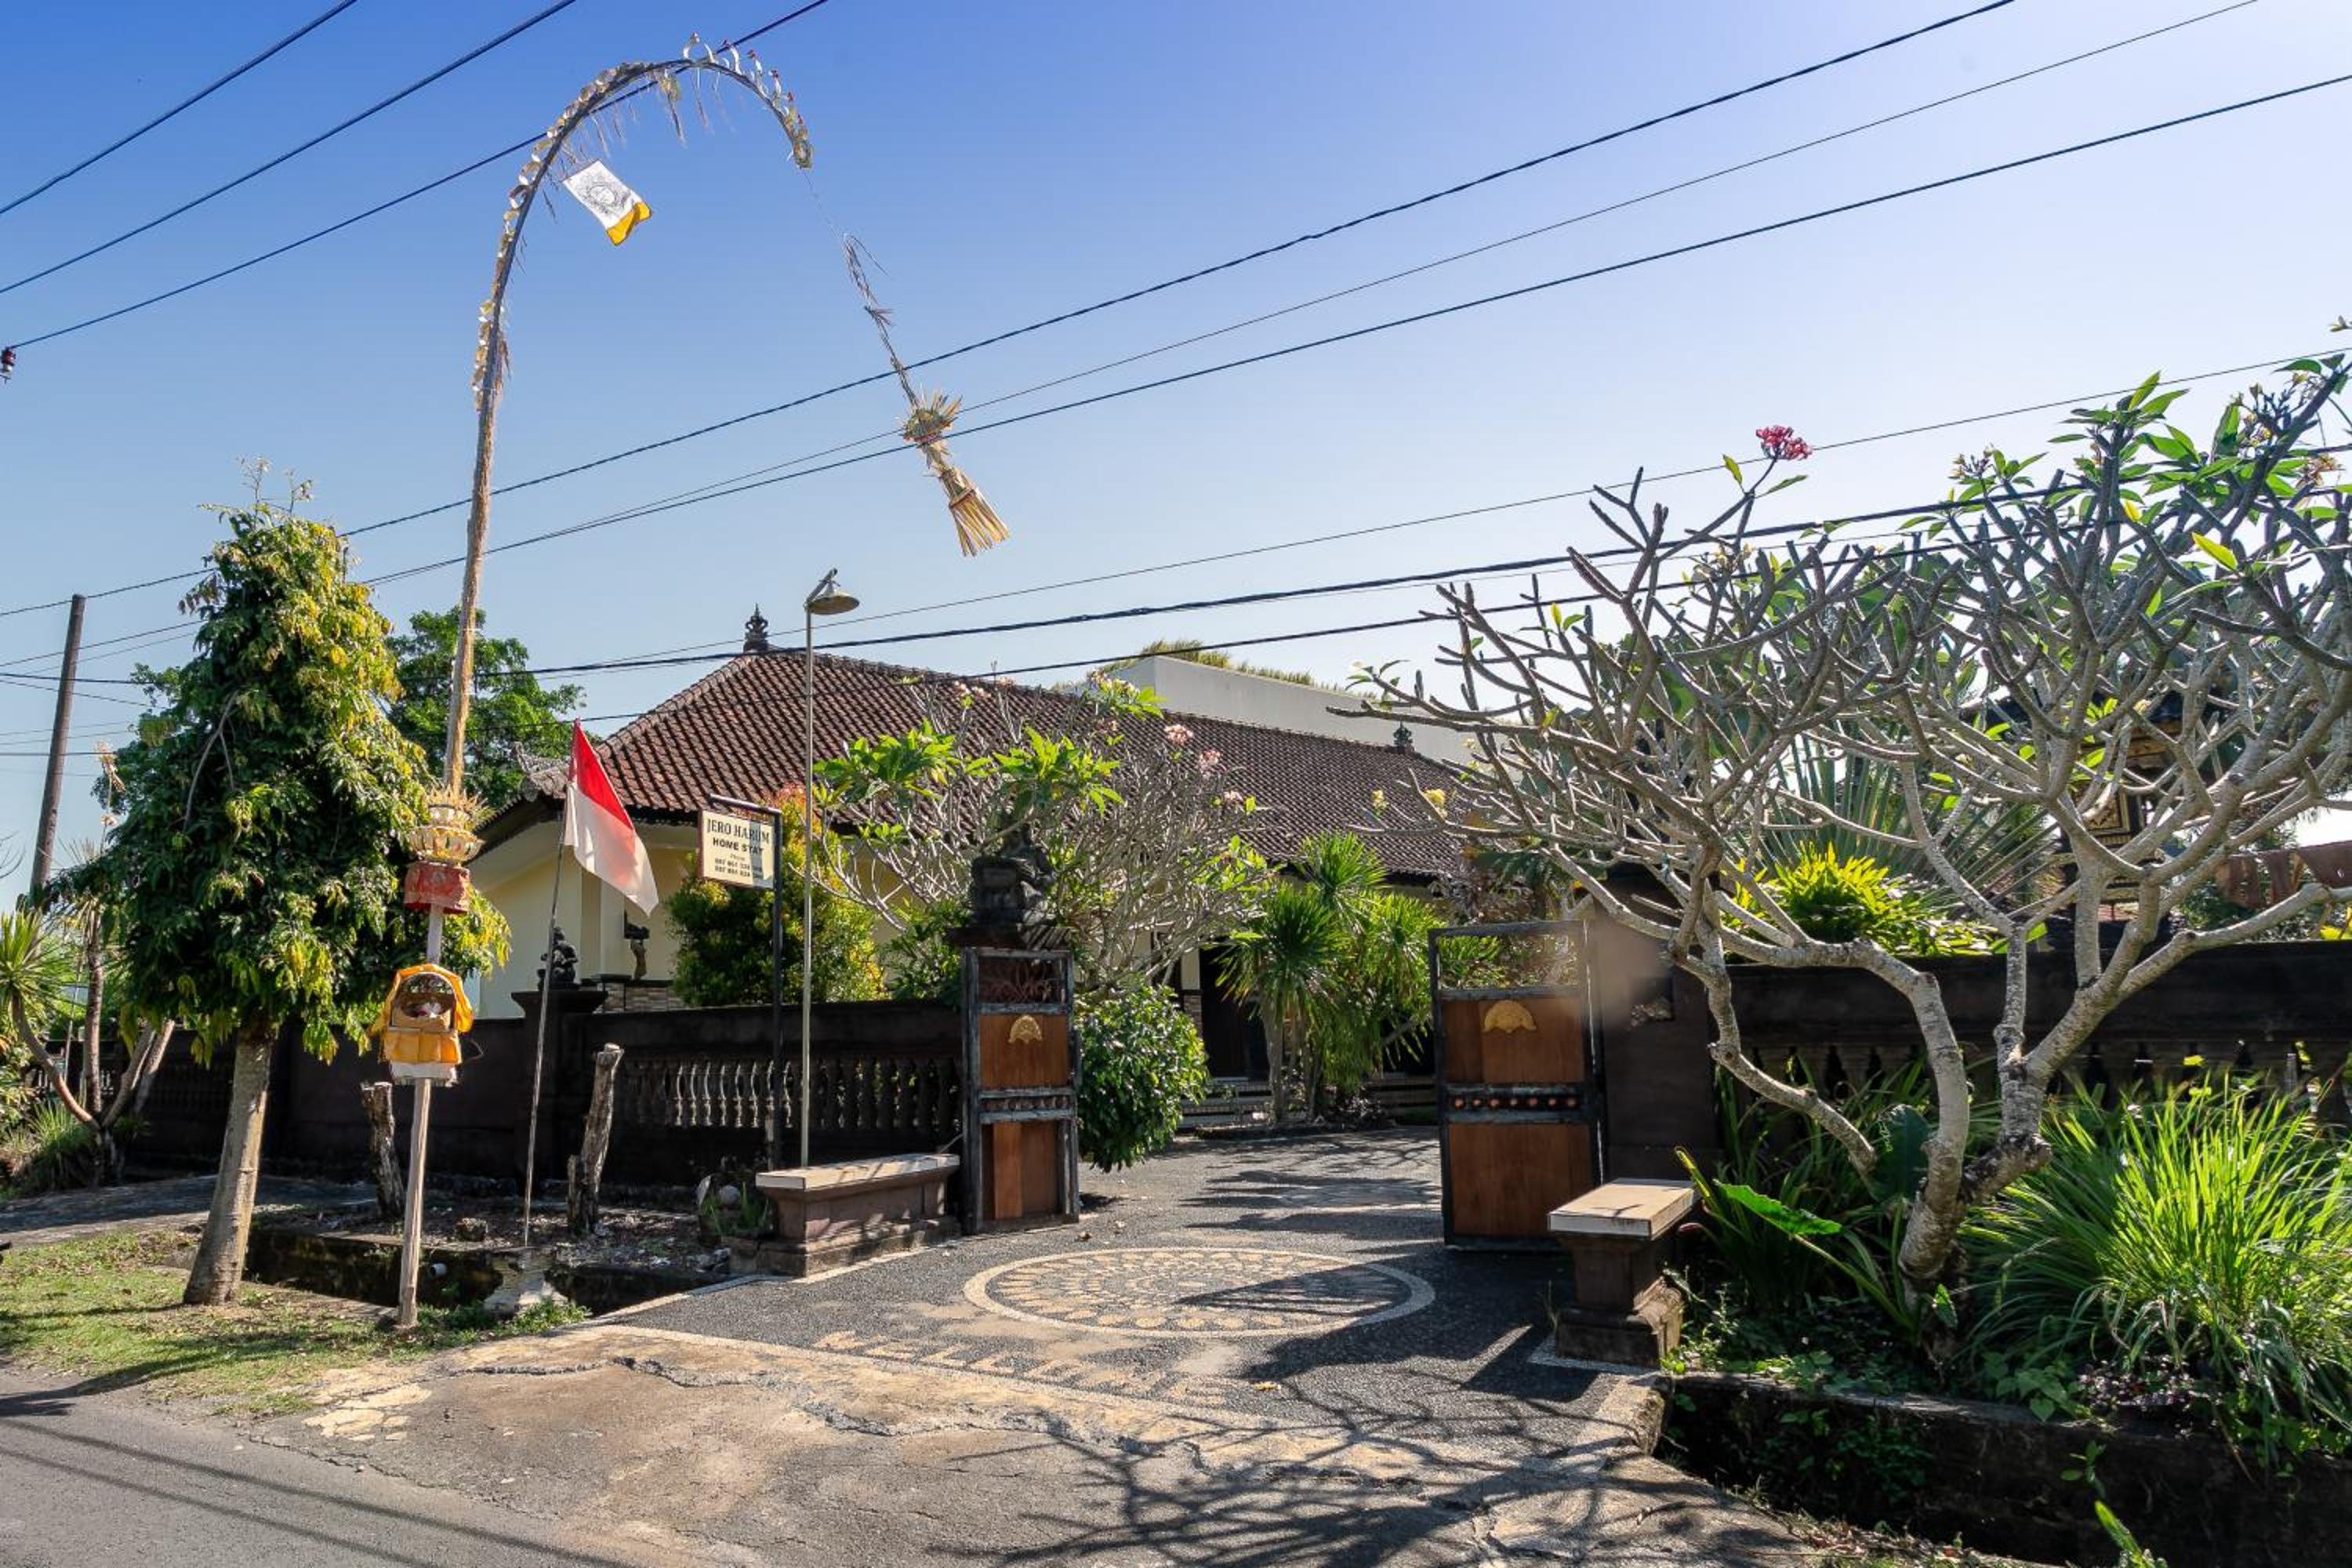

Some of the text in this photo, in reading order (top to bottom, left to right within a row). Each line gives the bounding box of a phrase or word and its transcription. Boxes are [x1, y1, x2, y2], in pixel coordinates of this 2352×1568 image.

[706, 818, 731, 835] JERO
[713, 837, 764, 854] HOME STAY
